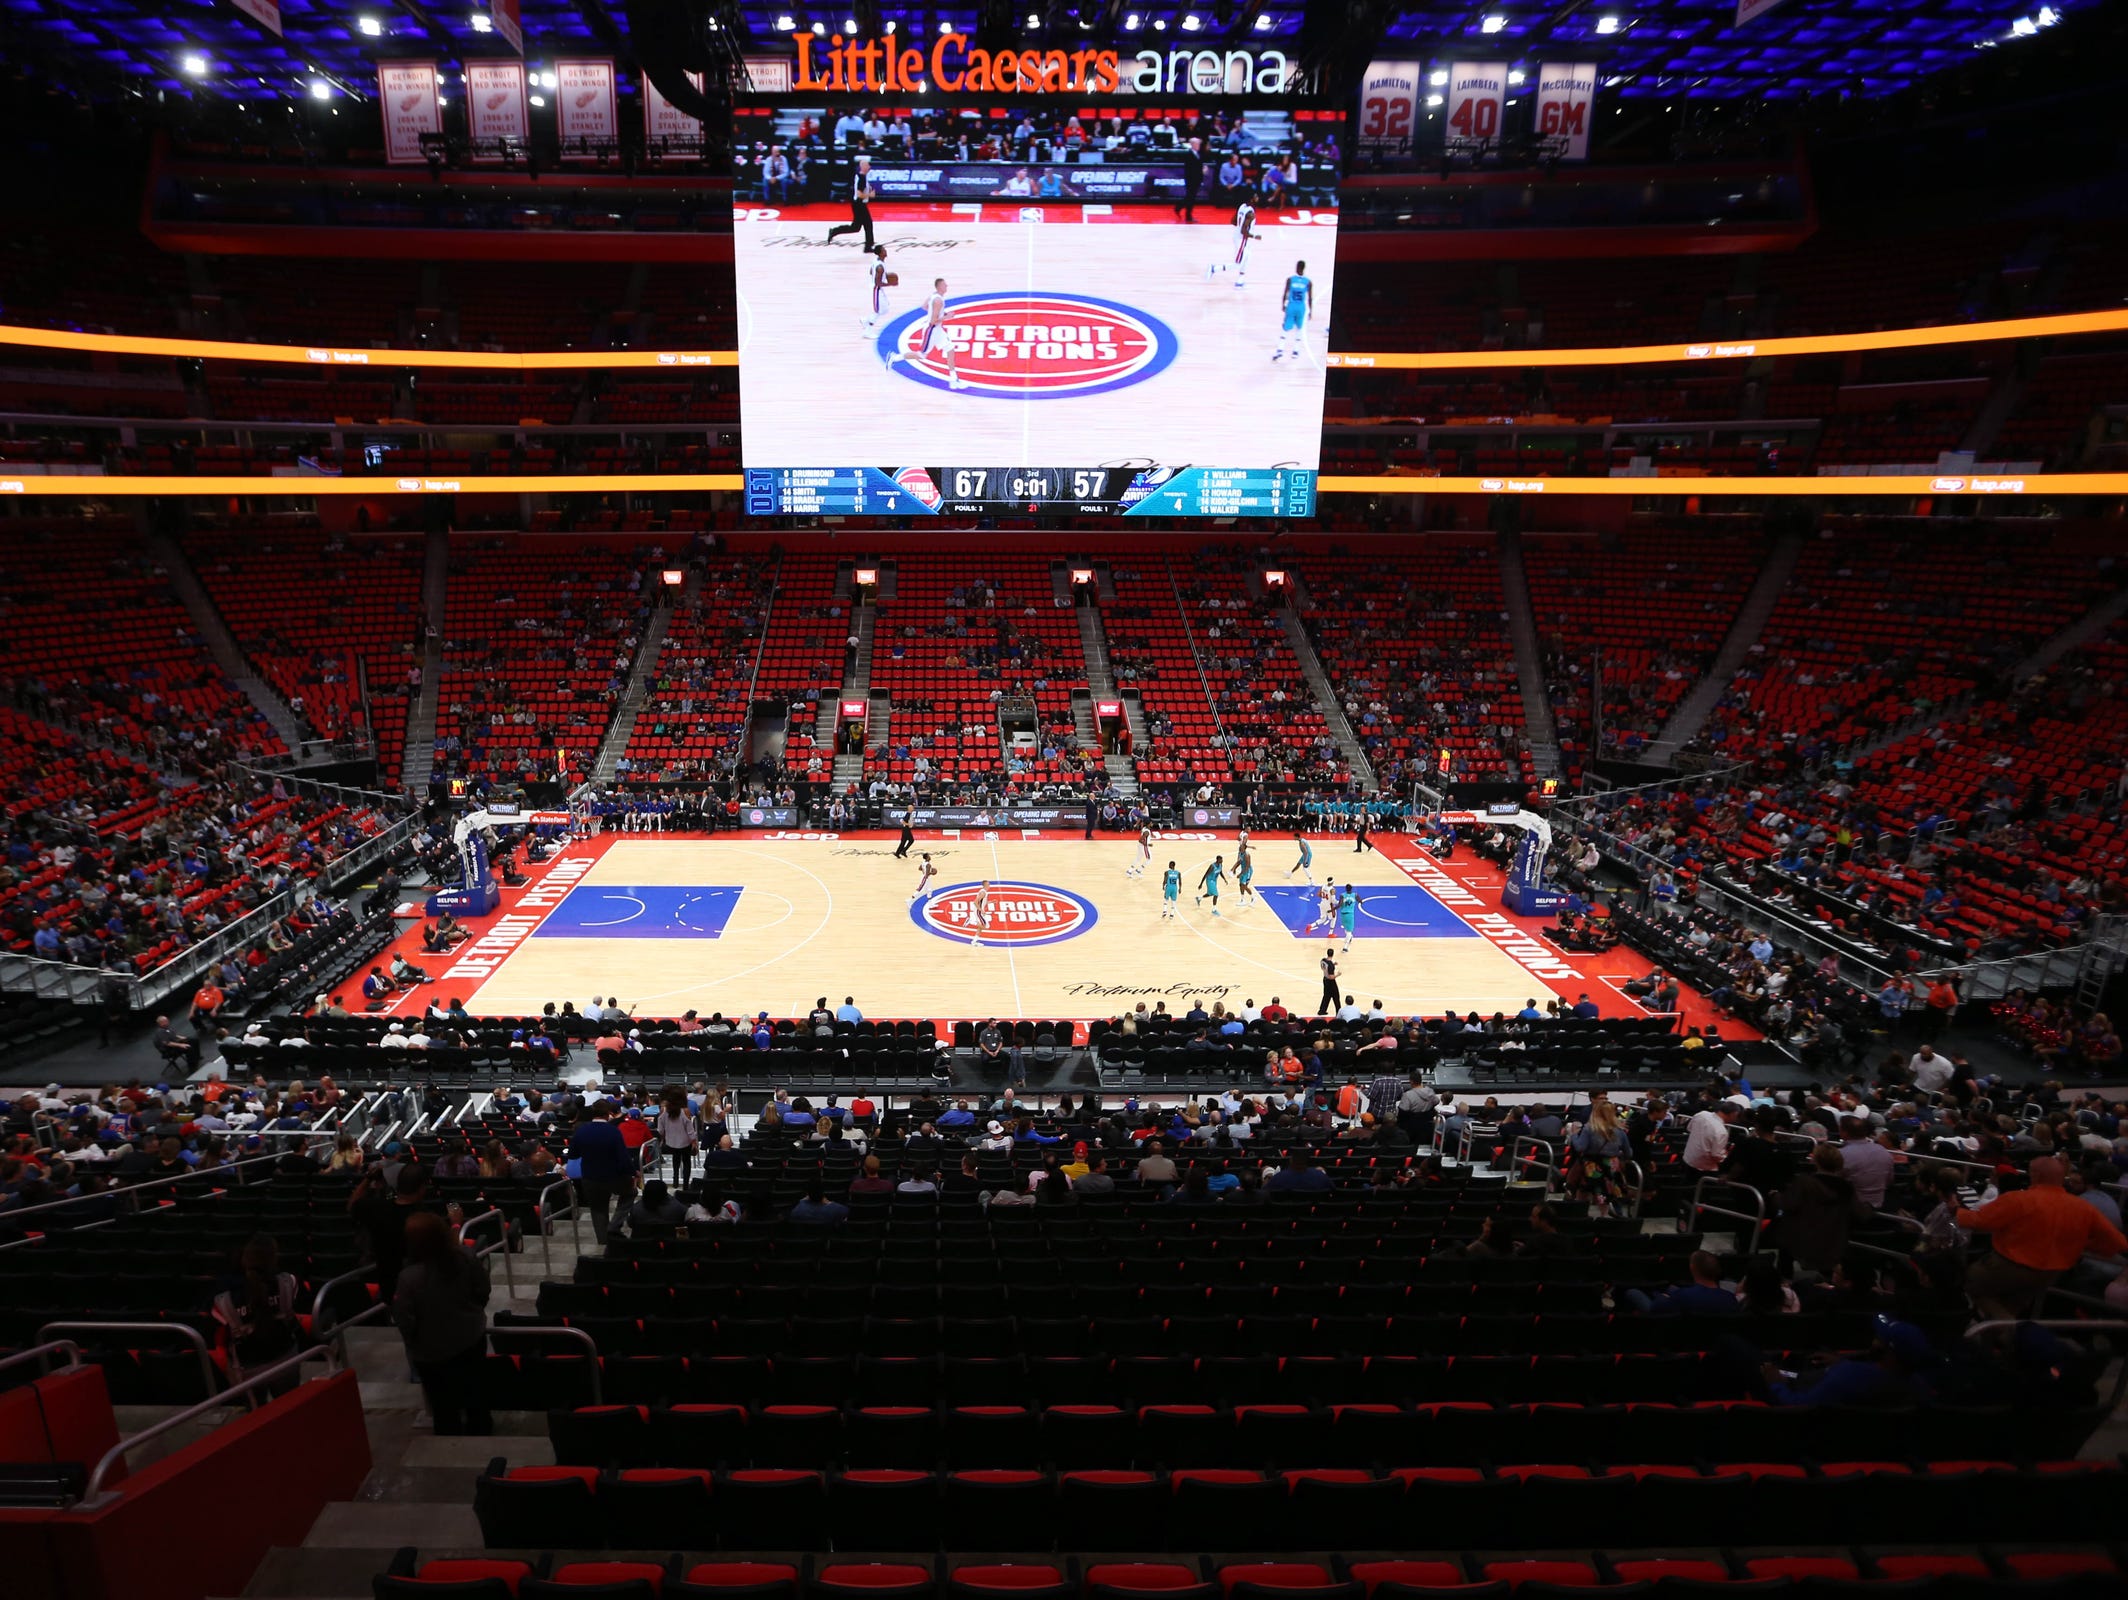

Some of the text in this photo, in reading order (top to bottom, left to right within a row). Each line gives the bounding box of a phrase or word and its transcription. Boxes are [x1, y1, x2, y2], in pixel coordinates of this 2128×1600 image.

[792, 32, 1287, 94] Little Caesars arena
[392, 72, 424, 81] DETROIT
[479, 71, 511, 79] DETROIT
[568, 69, 600, 77] DETROIT
[1369, 77, 1412, 91] HAMILTON
[1457, 78, 1499, 91] LAIMBEER
[1541, 79, 1592, 92] McCLOSKEY
[1364, 97, 1411, 137] 32
[1450, 97, 1498, 137] 40
[1540, 101, 1586, 136] GM
[910, 169, 943, 182] NIGHT
[1070, 171, 1148, 184] OPENING NIGHT
[1153, 178, 1186, 186] PISTONS
[882, 183, 917, 191] OCTOBER
[1086, 184, 1122, 192] OCTOBER
[947, 324, 1115, 343] DETROIT
[333, 351, 368, 364] hap.org
[941, 342, 1118, 360] PISTONS
[1715, 345, 1755, 357] hap.org
[792, 469, 835, 478] DRUMMOND
[1026, 470, 1040, 478] 3rd
[1211, 471, 1247, 480] WILLIAMS
[425, 479, 461, 492] hap.org
[955, 470, 988, 498] 67
[1013, 478, 1048, 497] 9:01
[1073, 471, 1106, 498] 57
[1508, 480, 1544, 493] hap.org
[1970, 479, 2024, 493] hap.org
[750, 470, 774, 514] DET
[782, 487, 792, 496] 14
[792, 487, 816, 496] SMITH
[1201, 489, 1210, 498] 12
[1211, 488, 1243, 498] HOWARD
[1289, 470, 1310, 517] CHA
[782, 496, 792, 505] 22
[793, 496, 825, 505] BRADLEY
[886, 497, 896, 511] 4
[1173, 498, 1183, 512] 4
[782, 505, 792, 513] 34
[793, 505, 820, 513] HARRIS
[1027, 504, 1038, 513] 21
[1080, 505, 1104, 513] FOULS:
[1210, 506, 1240, 515] WALKER
[1013, 810, 1060, 819] OPENING NIGHT
[764, 831, 840, 841] Jeep
[440, 857, 596, 980] DETROIT PISTONS
[948, 911, 1061, 923] PSTONS
[1393, 857, 1586, 980] DETROIT PISTONS
[1062, 982, 1229, 999] Platinum Equity
